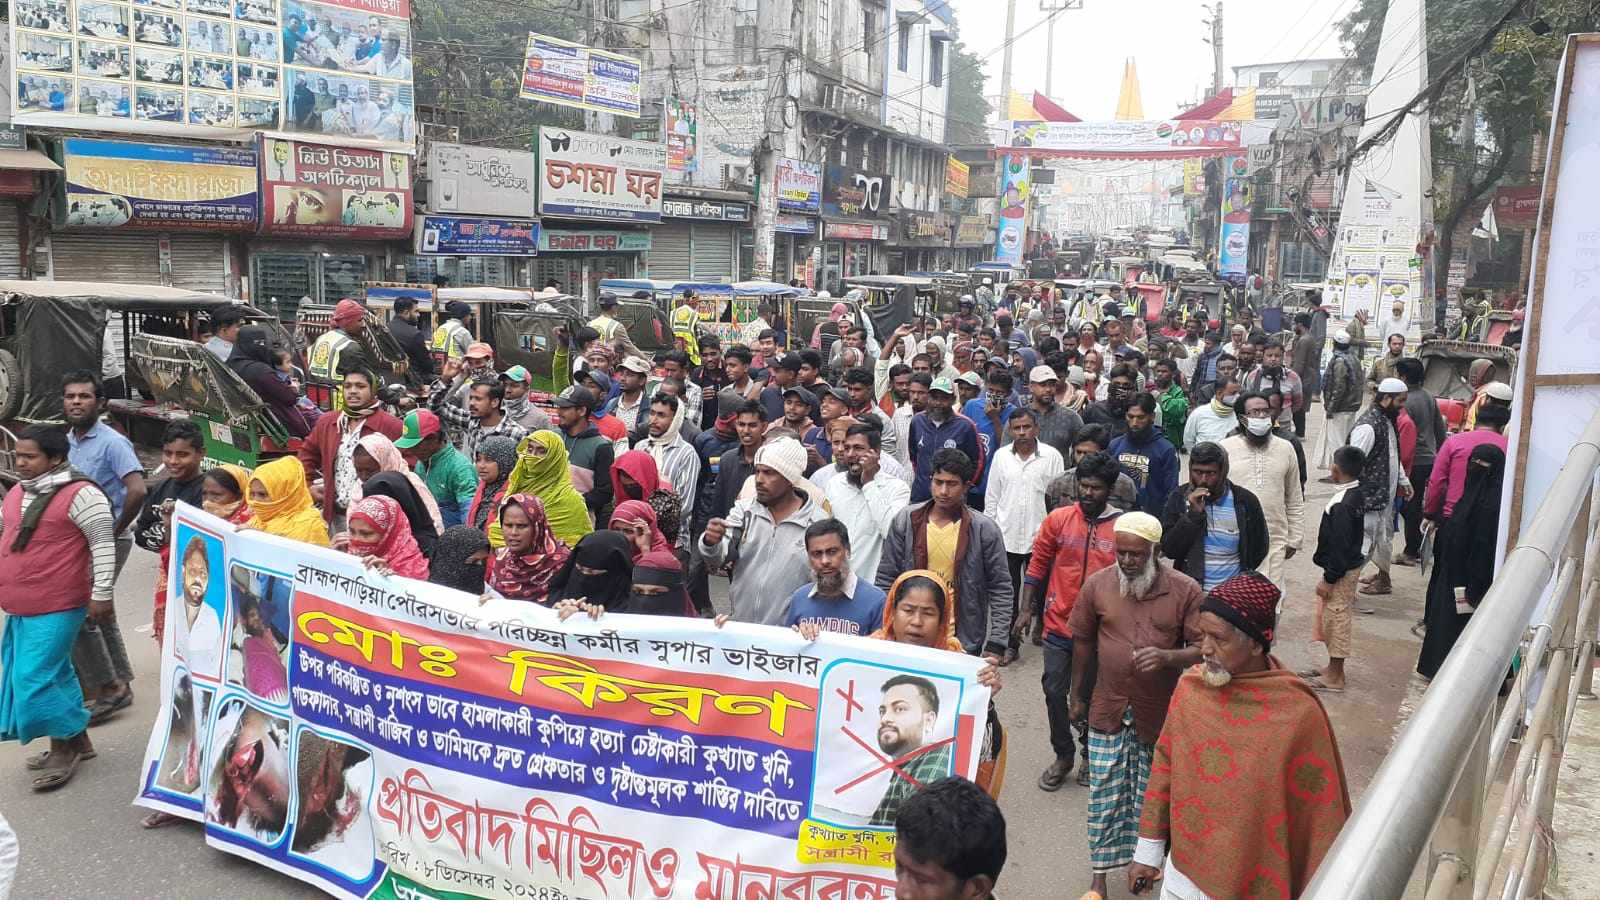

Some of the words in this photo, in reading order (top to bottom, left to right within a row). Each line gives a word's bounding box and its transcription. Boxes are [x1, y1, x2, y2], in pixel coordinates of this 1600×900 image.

[545, 158, 617, 195] চশমা
[625, 168, 662, 205] ঘর
[297, 611, 458, 678] মোঃ
[491, 650, 814, 737] কিরণ
[573, 629, 641, 654] কর্মীর
[648, 639, 714, 665] সুপার
[720, 646, 821, 678] ভাইজার
[299, 648, 324, 680] উপর
[373, 683, 382, 701] ও
[426, 693, 459, 723] ভাবে
[461, 701, 533, 737] হামলাকারী
[590, 726, 626, 755] হত্যা
[702, 744, 758, 776] কুখ্যাত
[376, 768, 520, 872] প্রতিবাদ
[377, 715, 413, 747] রাজিব
[417, 729, 427, 748] ও
[432, 728, 493, 764] তামিমকে
[592, 766, 605, 785] ও
[743, 787, 803, 821] দাবিতে
